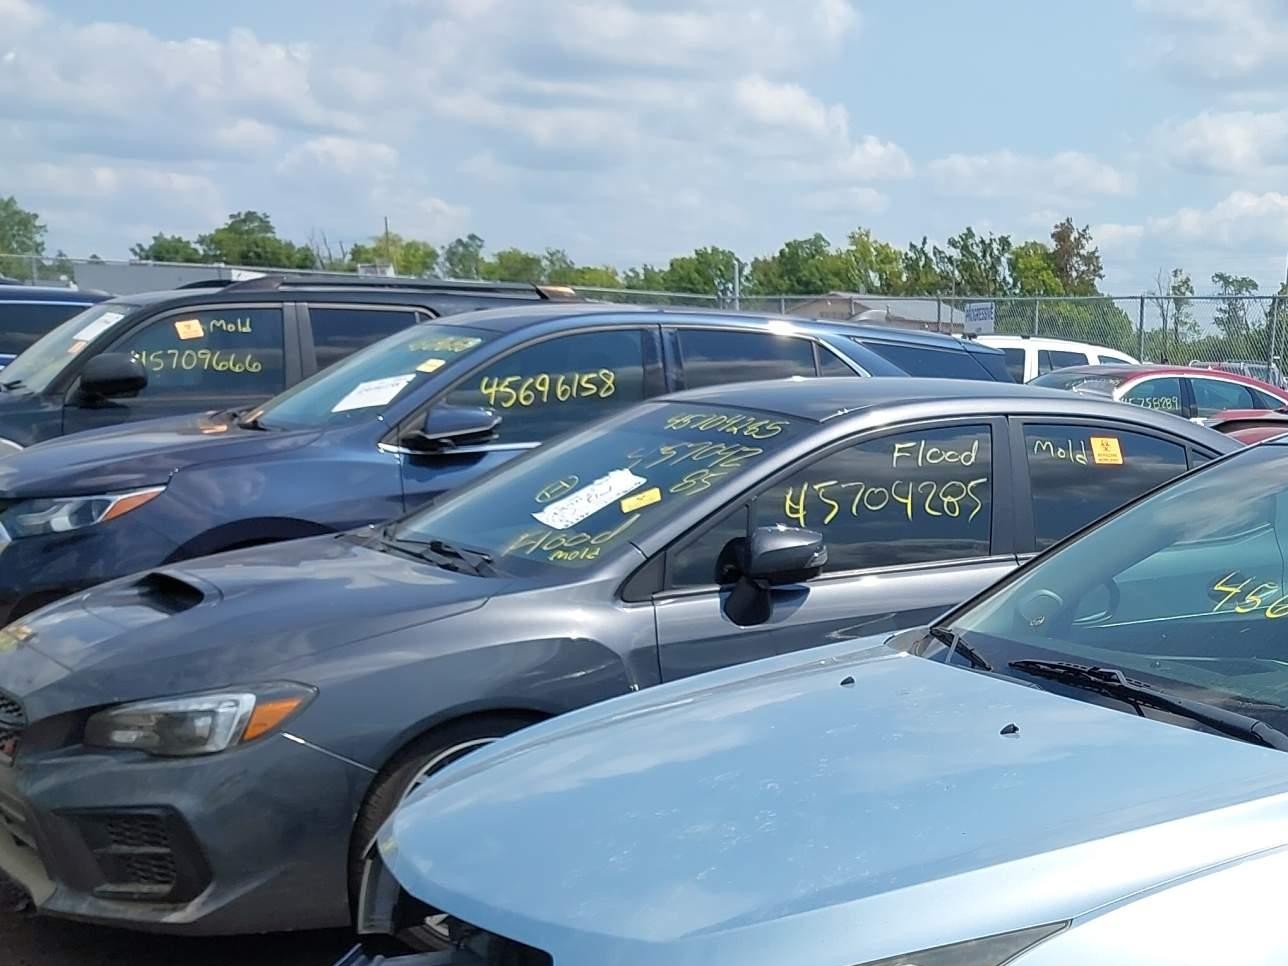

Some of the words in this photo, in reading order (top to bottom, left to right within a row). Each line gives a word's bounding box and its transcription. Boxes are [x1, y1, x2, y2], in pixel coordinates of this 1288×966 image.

[480, 369, 616, 408] 45696158
[893, 440, 979, 468] Flood
[784, 478, 988, 528] 45704285
